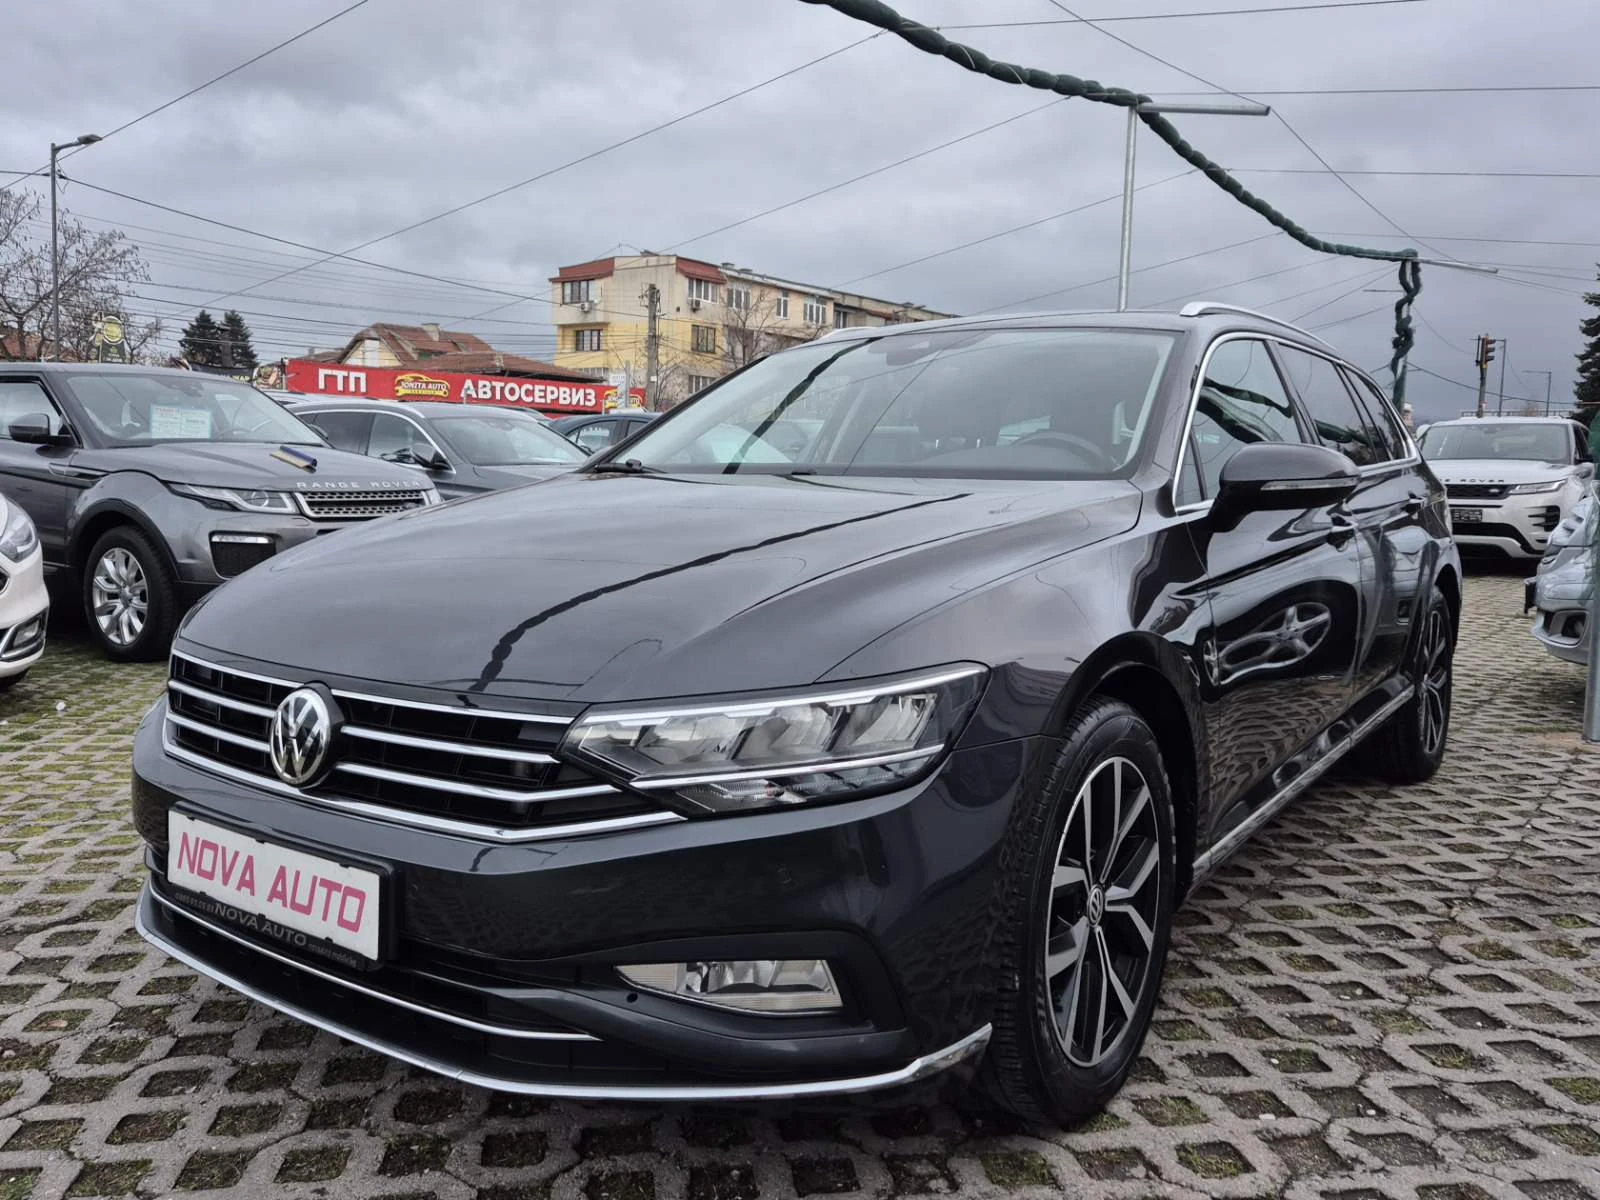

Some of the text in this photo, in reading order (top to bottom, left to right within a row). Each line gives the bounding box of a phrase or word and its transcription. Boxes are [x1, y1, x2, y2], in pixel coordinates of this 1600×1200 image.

[318, 368, 367, 393] ГТП
[460, 378, 596, 407] АВТОСЕРВИЗ
[296, 480, 420, 489] RANGE ROVER
[177, 831, 367, 933] NOVA AUTO
[213, 902, 260, 931] NOVA
[261, 920, 308, 947] AUTO
